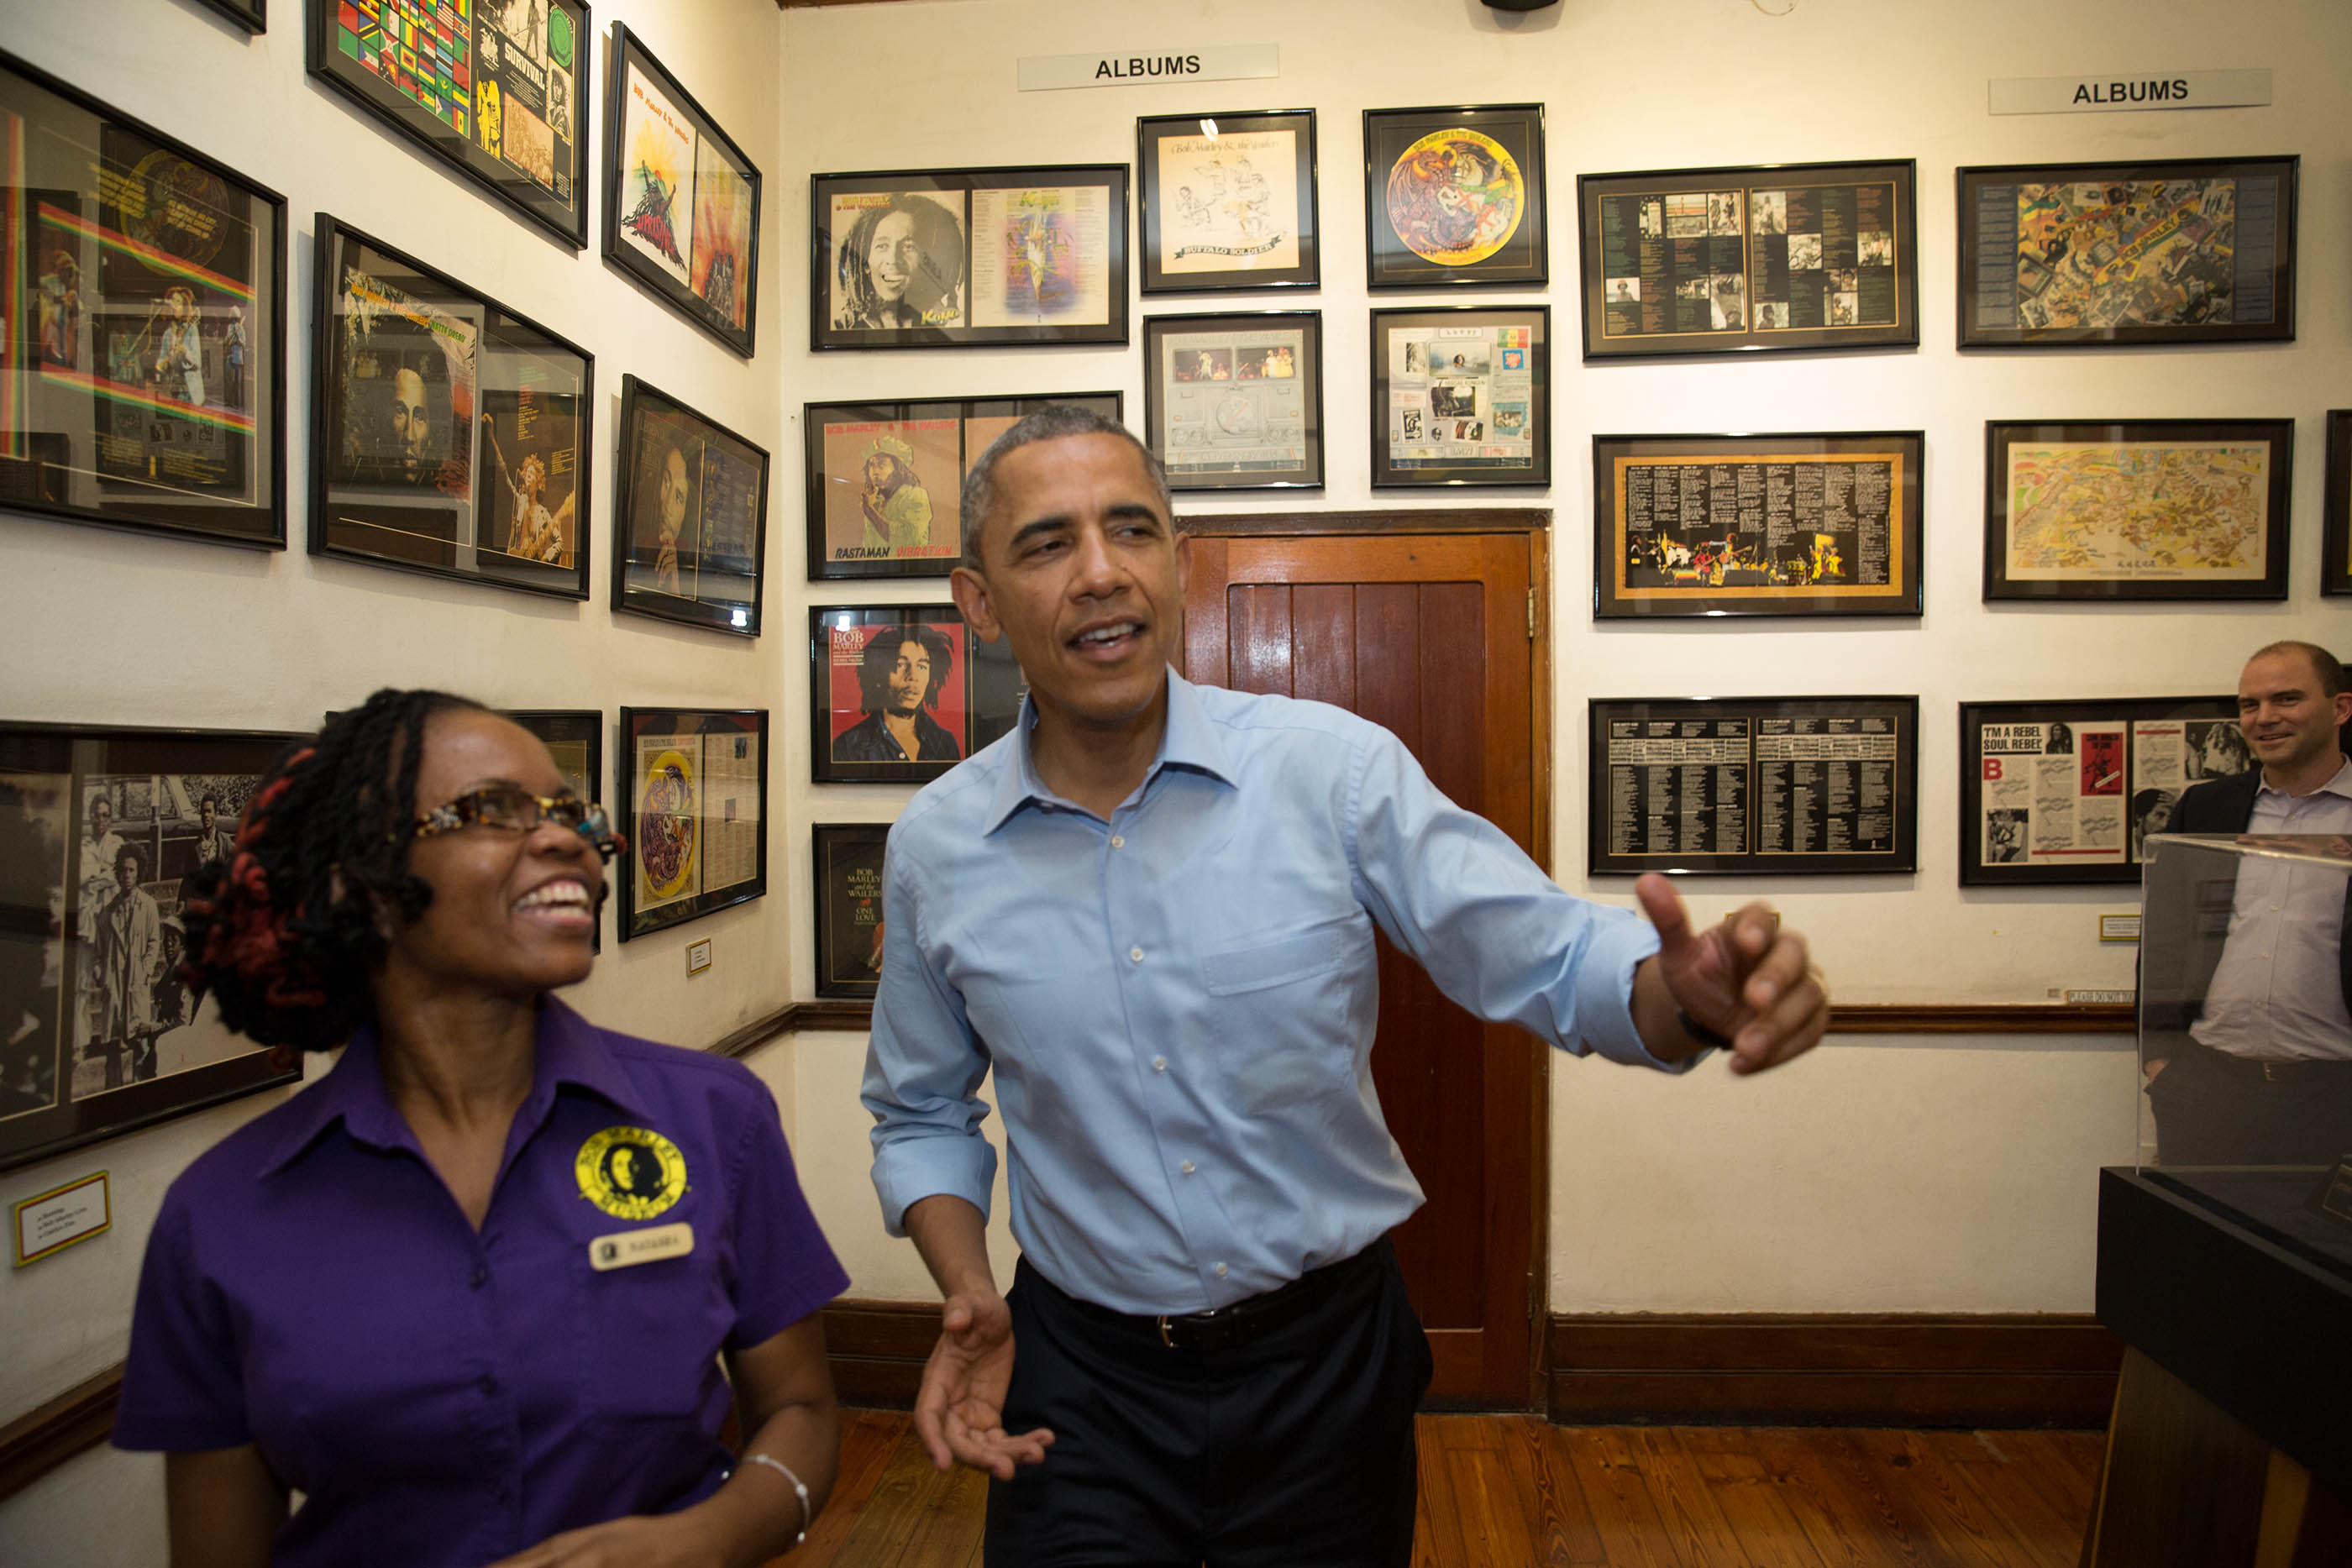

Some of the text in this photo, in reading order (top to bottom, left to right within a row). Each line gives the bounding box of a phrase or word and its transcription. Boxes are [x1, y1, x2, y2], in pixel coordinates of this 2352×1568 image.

[504, 41, 545, 91] SURVIVAL
[1095, 55, 1201, 79] ALBUMS
[2072, 79, 2189, 104] ALBUMS
[637, 212, 675, 254] UPRISING
[921, 308, 959, 325] Kaya
[835, 544, 953, 559] RASTAMAN VIBRATION
[834, 631, 864, 643] BOB
[2003, 726, 2010, 738] A
[2013, 726, 2041, 737] REBEL
[1983, 739, 2009, 750] SOUL
[1983, 758, 2003, 780] B
[2068, 991, 2094, 1003] PLEASE
